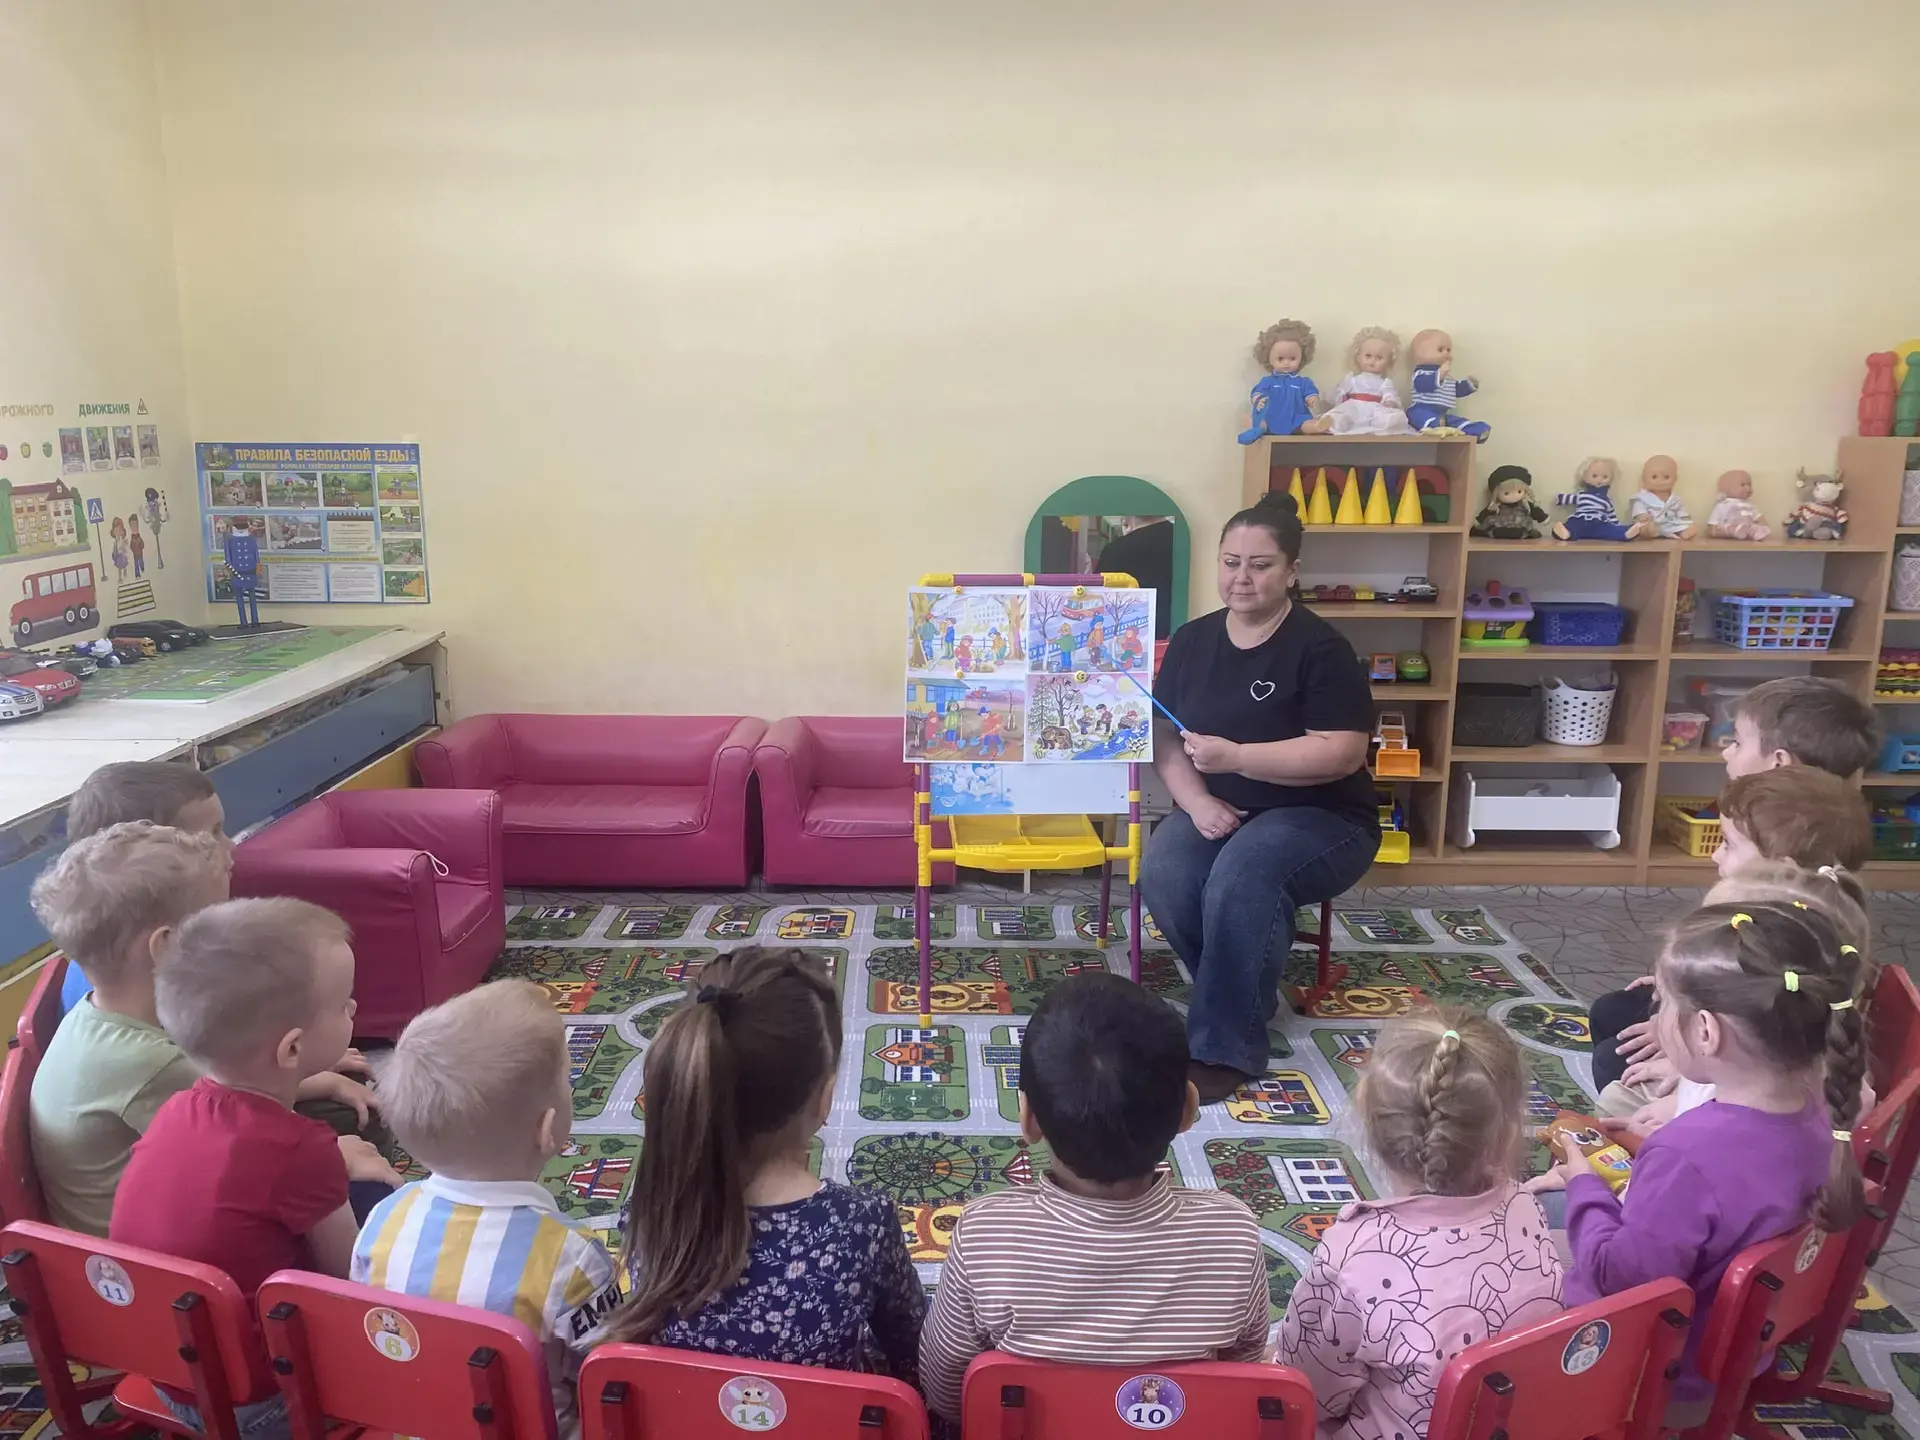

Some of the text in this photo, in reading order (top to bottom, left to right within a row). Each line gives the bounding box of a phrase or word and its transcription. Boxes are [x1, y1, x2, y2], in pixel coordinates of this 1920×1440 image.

[0, 403, 130, 418] РОЖНОГО ДВИЖЕНИЯ
[235, 448, 292, 461] ПРАВИЛА
[295, 447, 371, 461] БЕЗОПАСНОЙ
[374, 449, 409, 463] ЕЗДЫ
[103, 1285, 126, 1301] 11
[385, 1336, 403, 1357] 6
[737, 1409, 770, 1426] 14
[1132, 1408, 1166, 1424] 10
